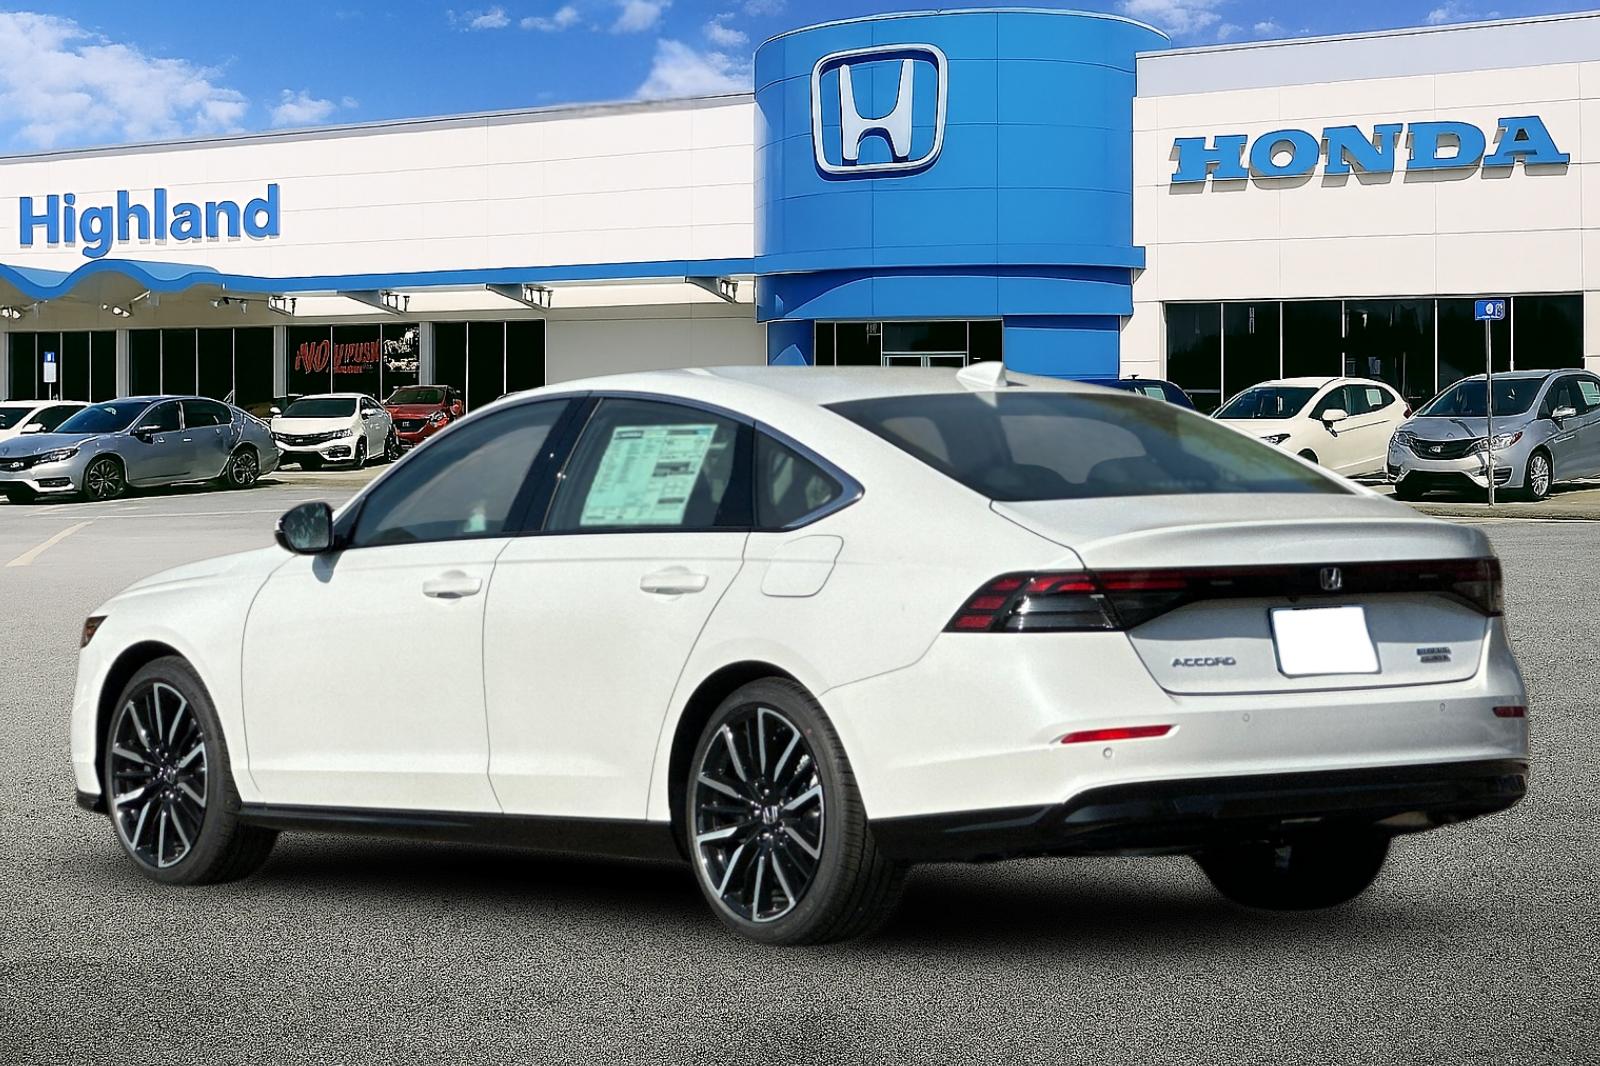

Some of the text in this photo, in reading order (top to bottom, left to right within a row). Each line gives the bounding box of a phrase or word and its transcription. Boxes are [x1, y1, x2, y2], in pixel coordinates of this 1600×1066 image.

[1171, 115, 1571, 183] HONDA
[19, 183, 280, 258] Highland
[1172, 656, 1237, 668] ACCORD
